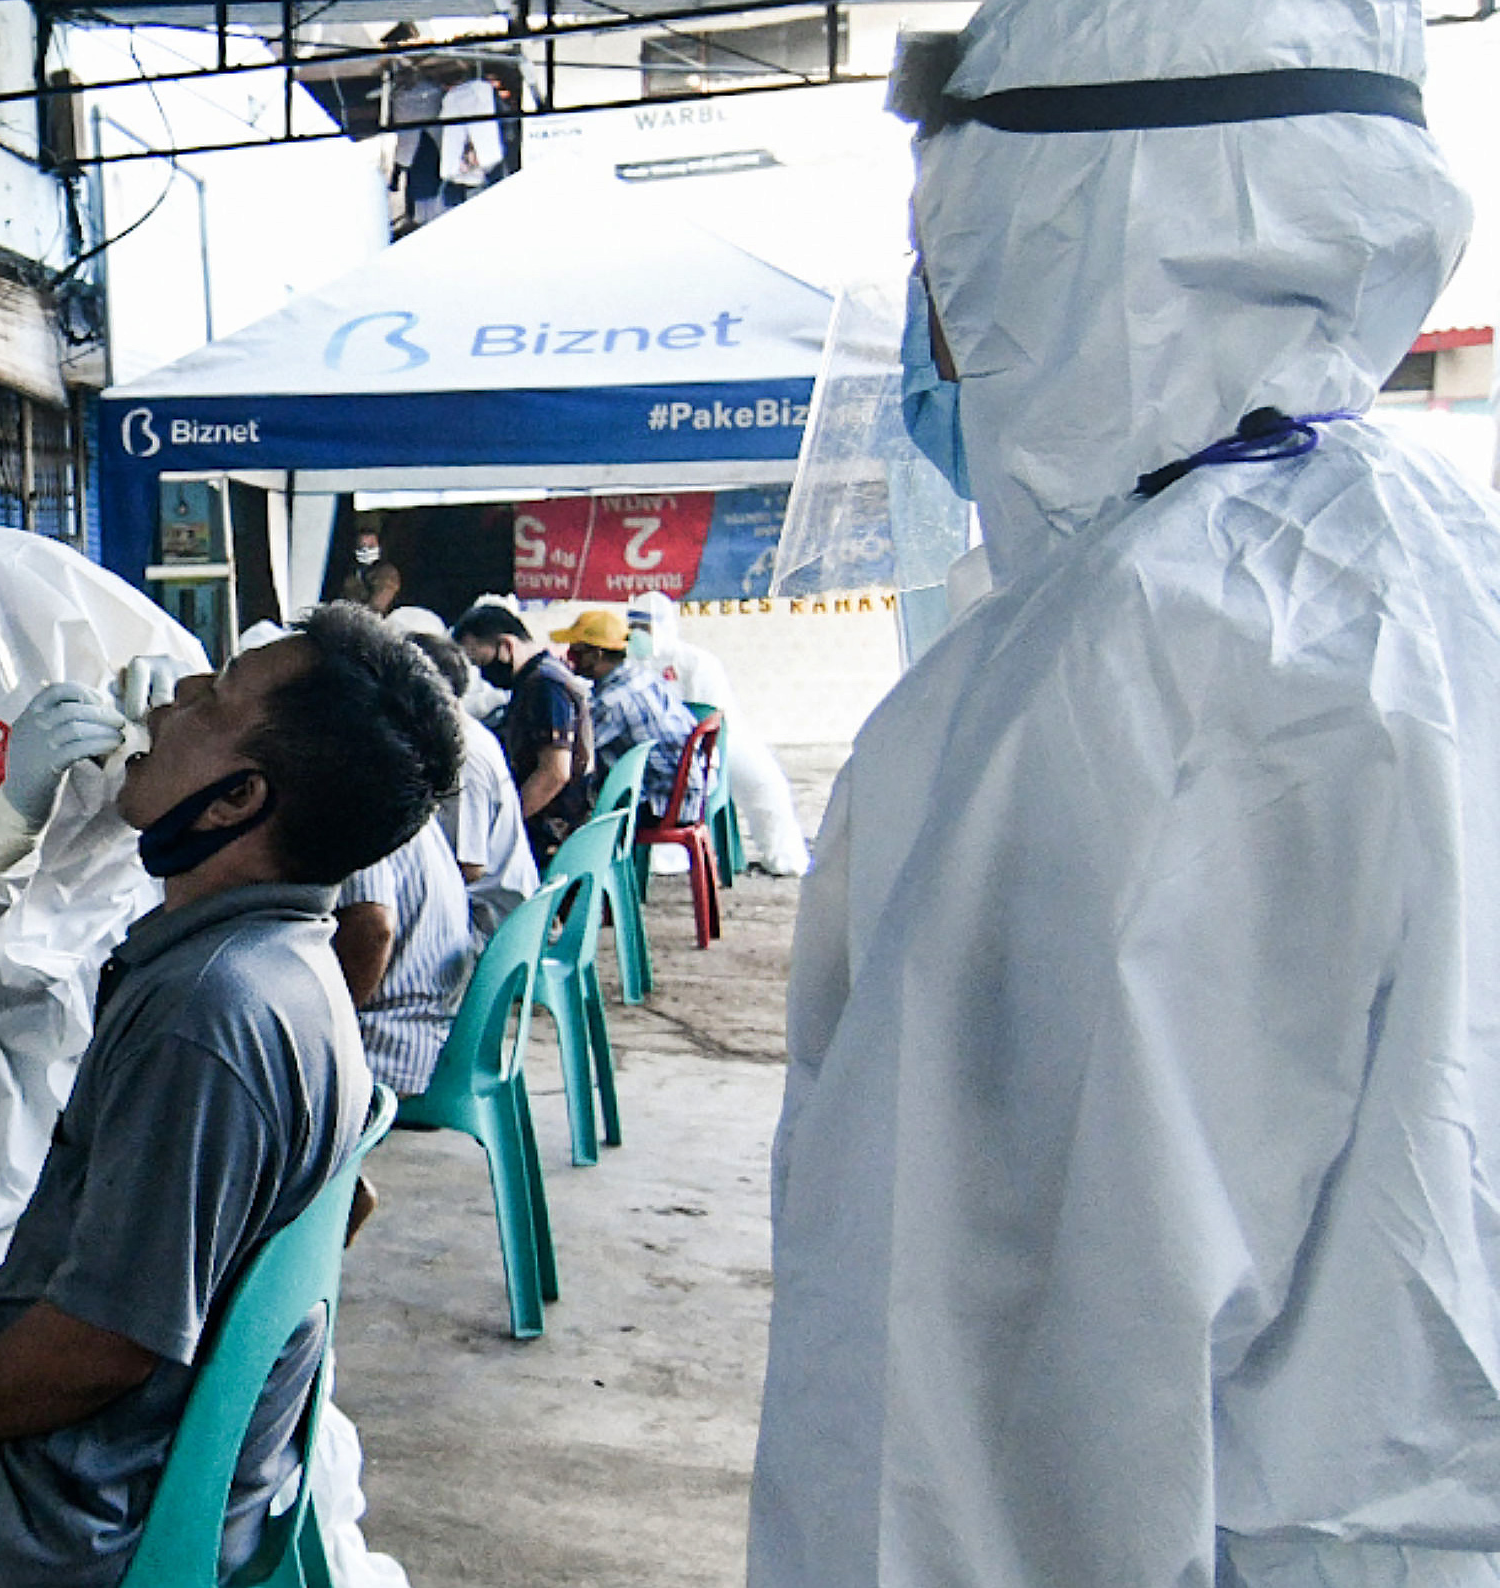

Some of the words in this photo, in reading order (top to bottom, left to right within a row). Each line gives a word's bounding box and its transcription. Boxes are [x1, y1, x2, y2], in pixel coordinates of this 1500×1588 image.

[469, 311, 742, 358] Biznet
[170, 418, 260, 445] Biznet
[622, 517, 664, 570] 2
[550, 549, 576, 569] Rp
[606, 573, 684, 591] RUMAH
